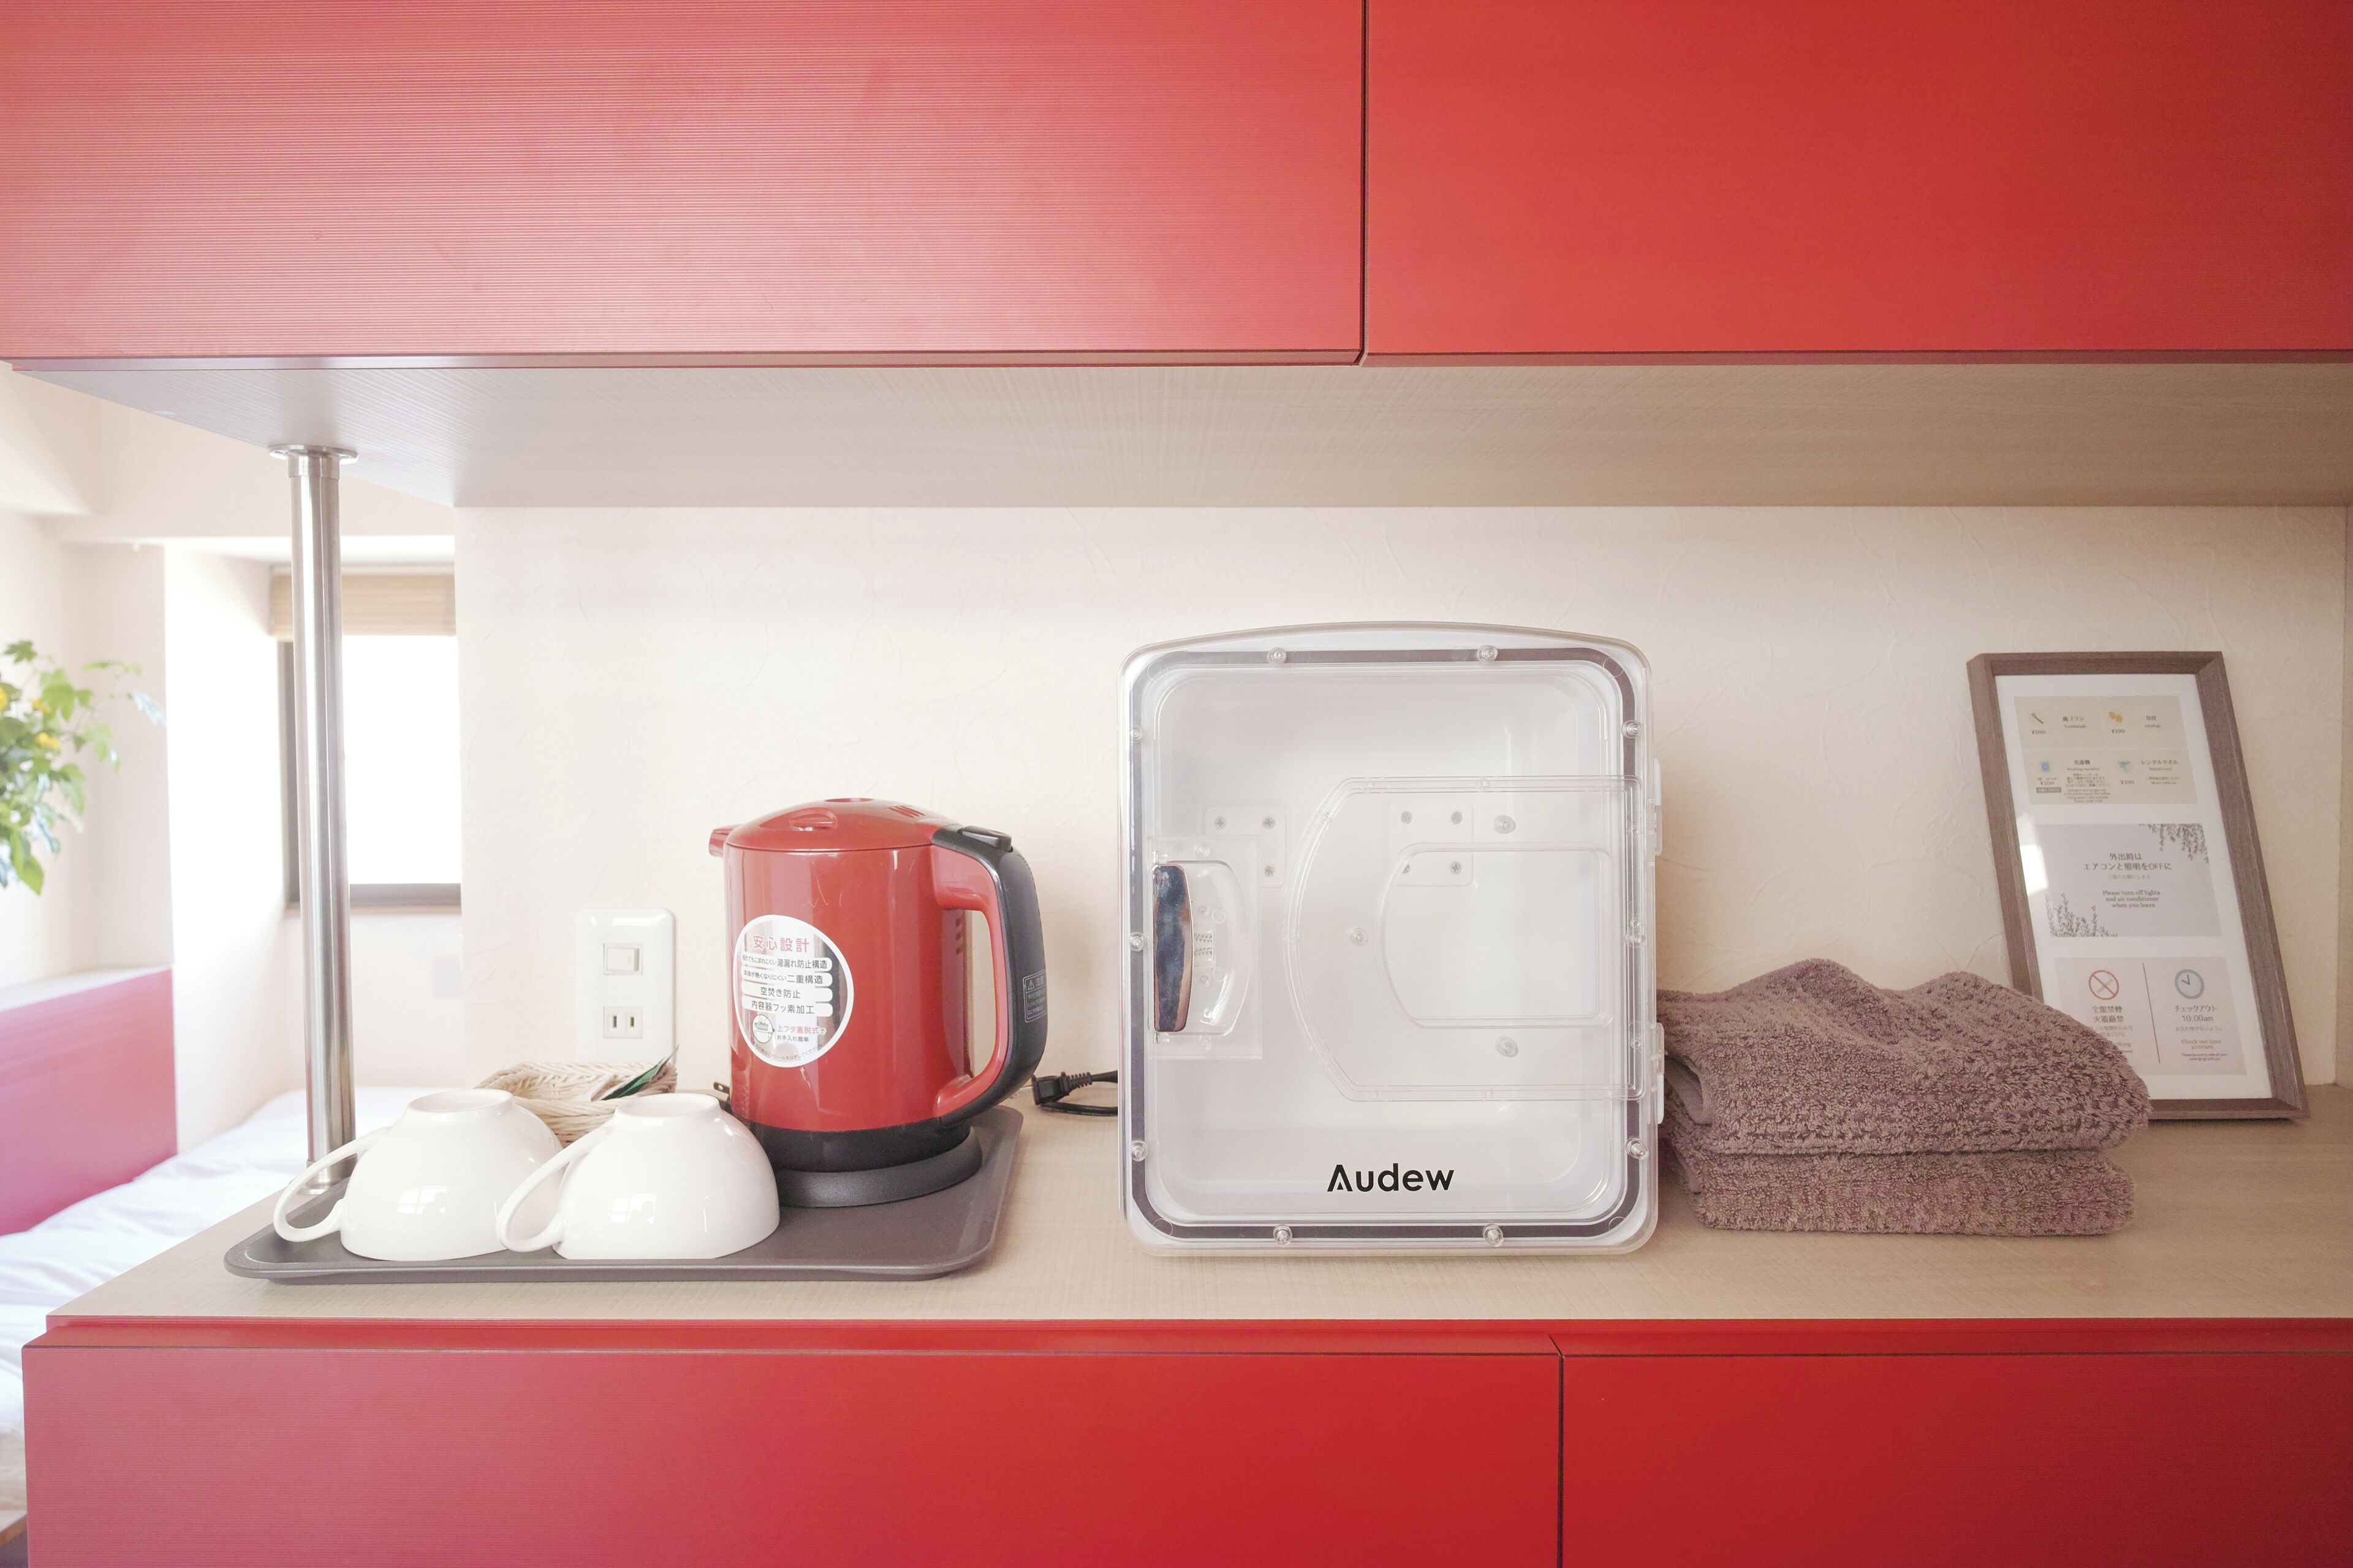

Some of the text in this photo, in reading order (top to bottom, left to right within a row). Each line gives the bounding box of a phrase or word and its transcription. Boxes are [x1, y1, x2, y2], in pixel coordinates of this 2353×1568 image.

[2109, 852, 2143, 861] 外出時は
[753, 934, 809, 953] 安心設計
[760, 987, 801, 999] 空焚き防止
[751, 999, 815, 1015] 内容器フッ素加工
[776, 1024, 825, 1034] 上フタ着脱式で
[1327, 1162, 1455, 1192] Audew
